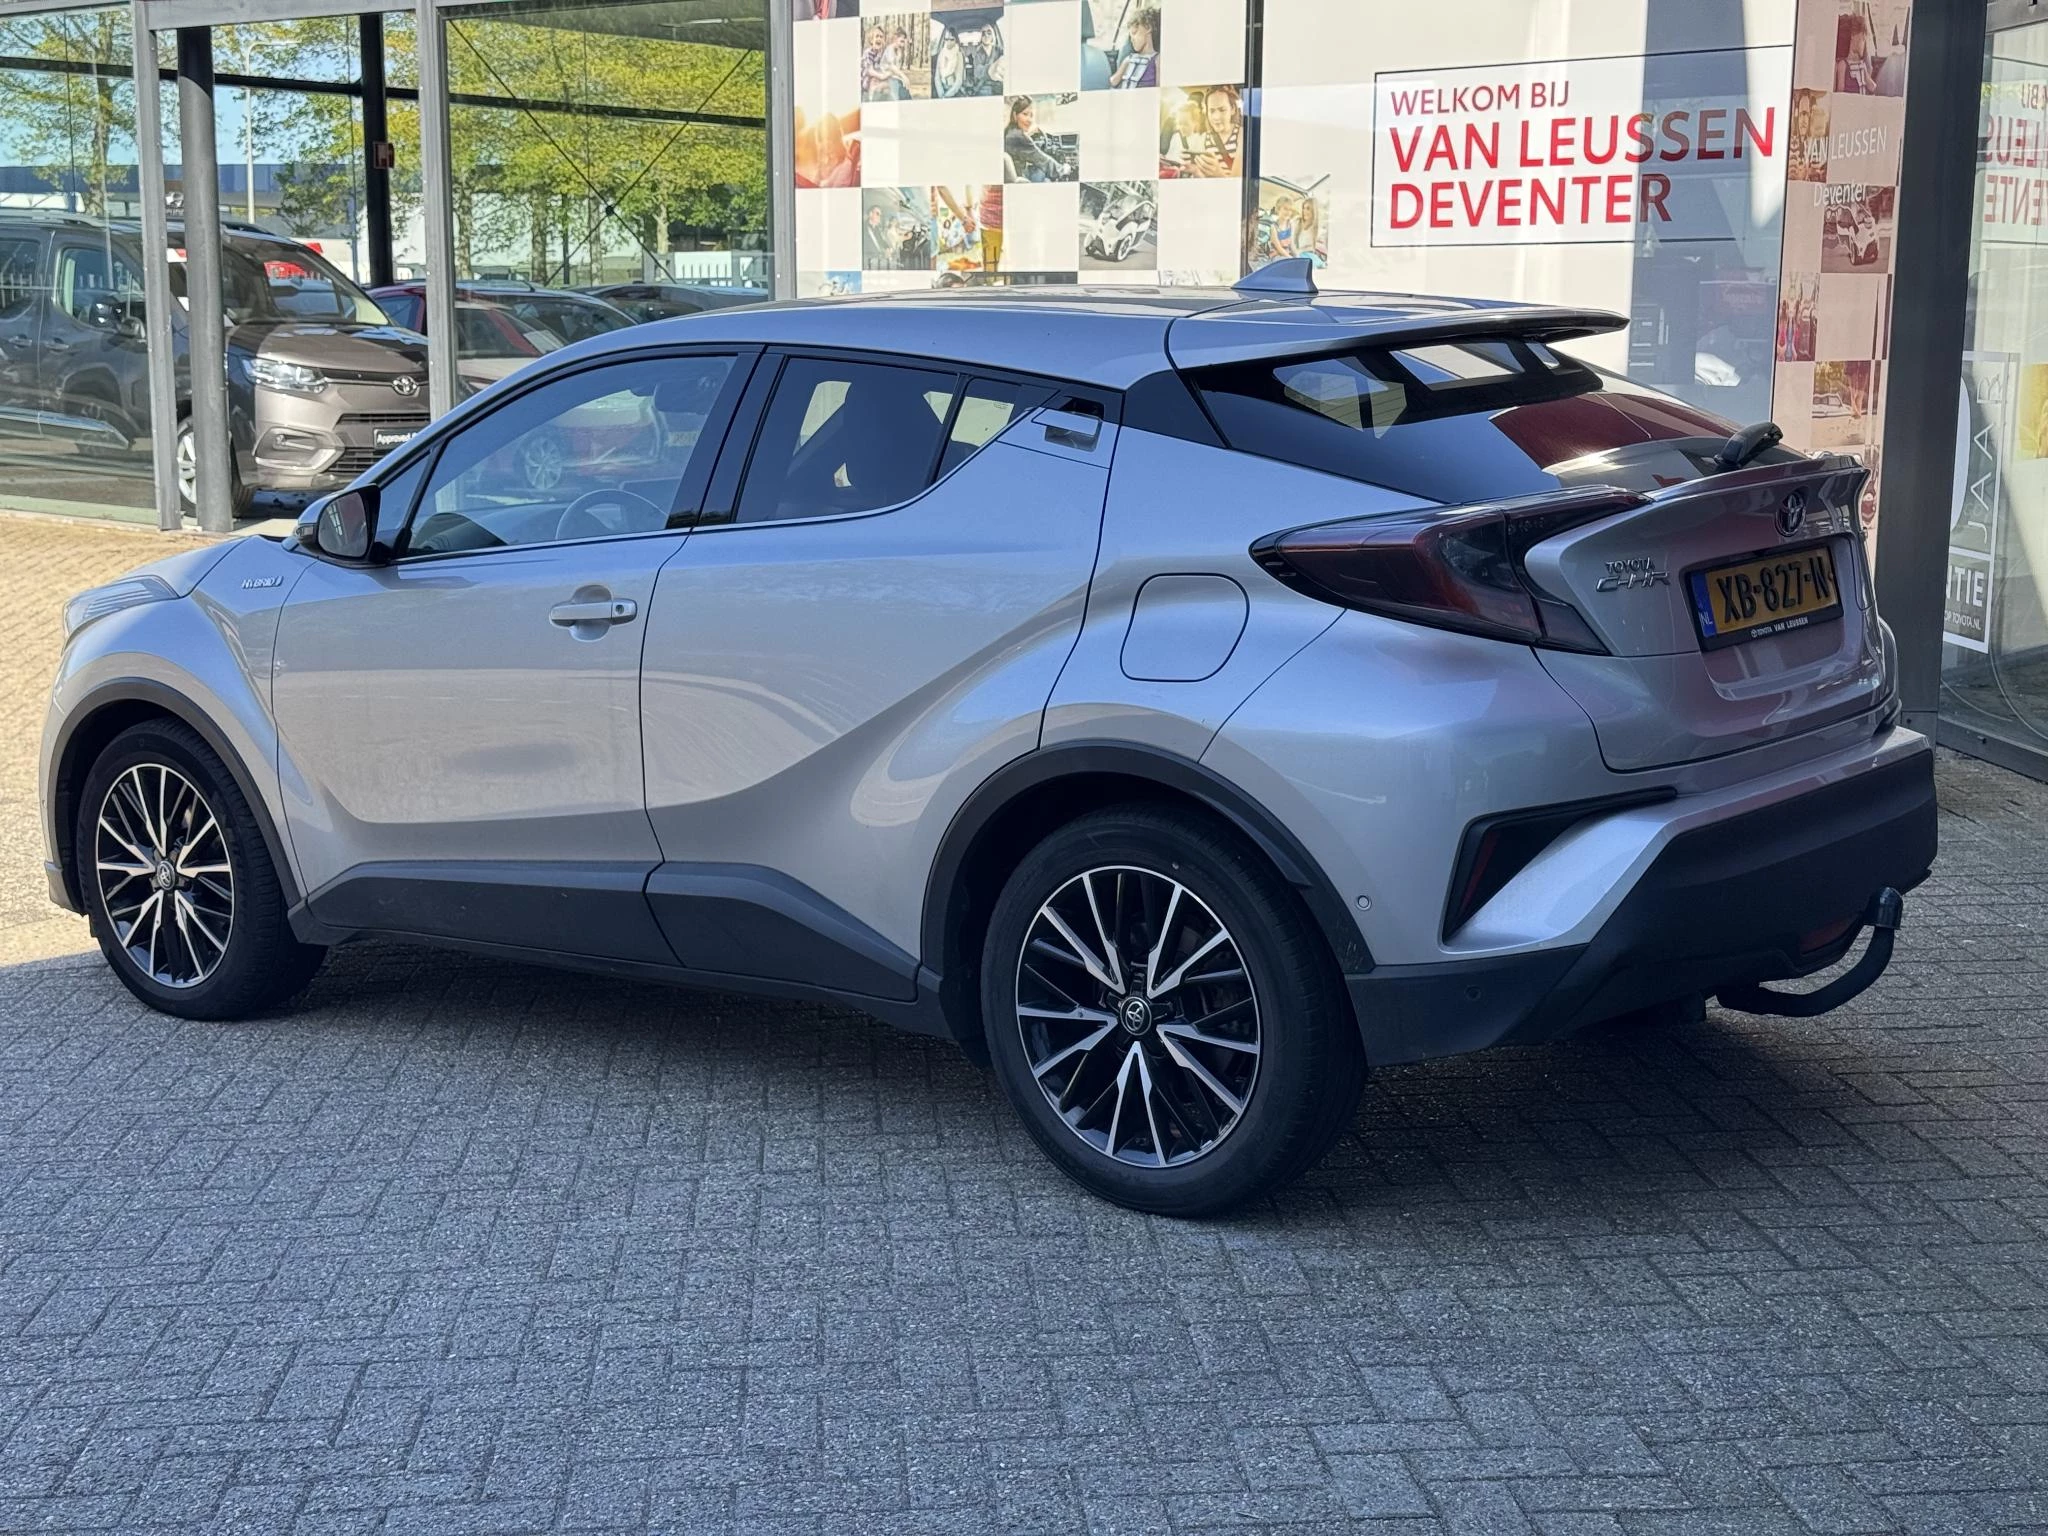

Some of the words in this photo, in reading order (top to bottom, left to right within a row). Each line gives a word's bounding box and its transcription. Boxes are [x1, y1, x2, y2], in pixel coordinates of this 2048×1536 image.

[1390, 84, 1521, 117] WELKOM
[1530, 80, 1570, 109] BIJ
[1389, 121, 1500, 172] VAN
[1519, 107, 1776, 167] LEUSSEN
[1803, 136, 1829, 165] VAN
[1831, 126, 1888, 160] LEUSSEN
[1390, 174, 1673, 229] DEVENTER
[1813, 180, 1867, 207] Deventer
[1605, 557, 1655, 573] TOYOTA
[1716, 556, 1829, 623] XB-827-N
[1699, 611, 1713, 626] NL
